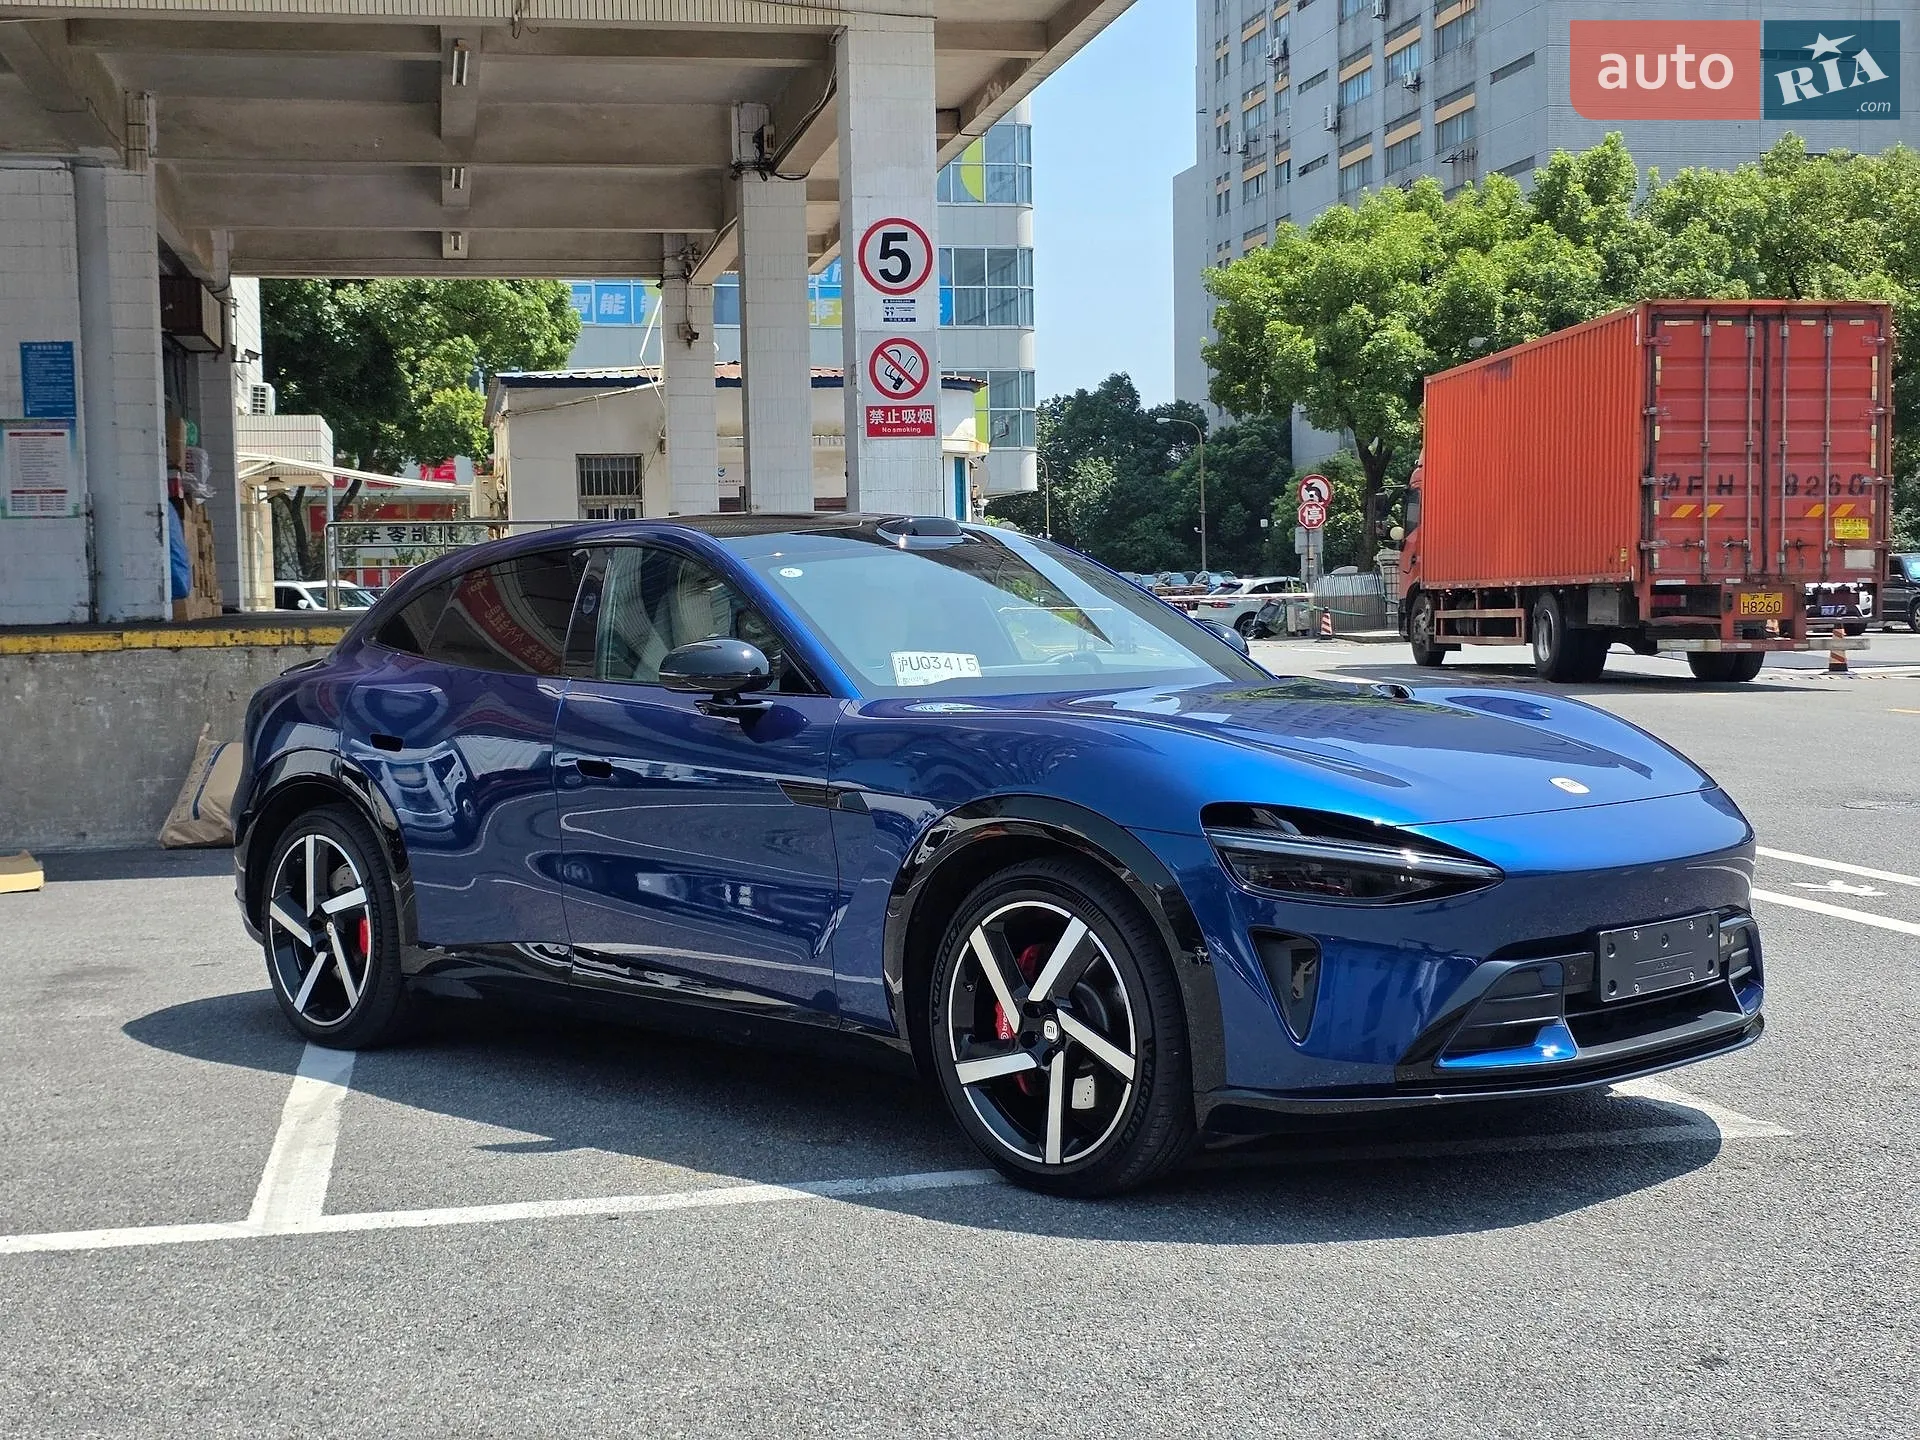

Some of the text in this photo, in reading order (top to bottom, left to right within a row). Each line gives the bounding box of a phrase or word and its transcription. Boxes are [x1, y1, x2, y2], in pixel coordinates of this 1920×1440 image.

[879, 232, 911, 283] 5
[869, 408, 933, 425] 禁止吸烟
[892, 426, 921, 434] smoking
[1784, 472, 1865, 497] 8260
[1303, 506, 1323, 525] 停
[1742, 600, 1781, 613] H8260
